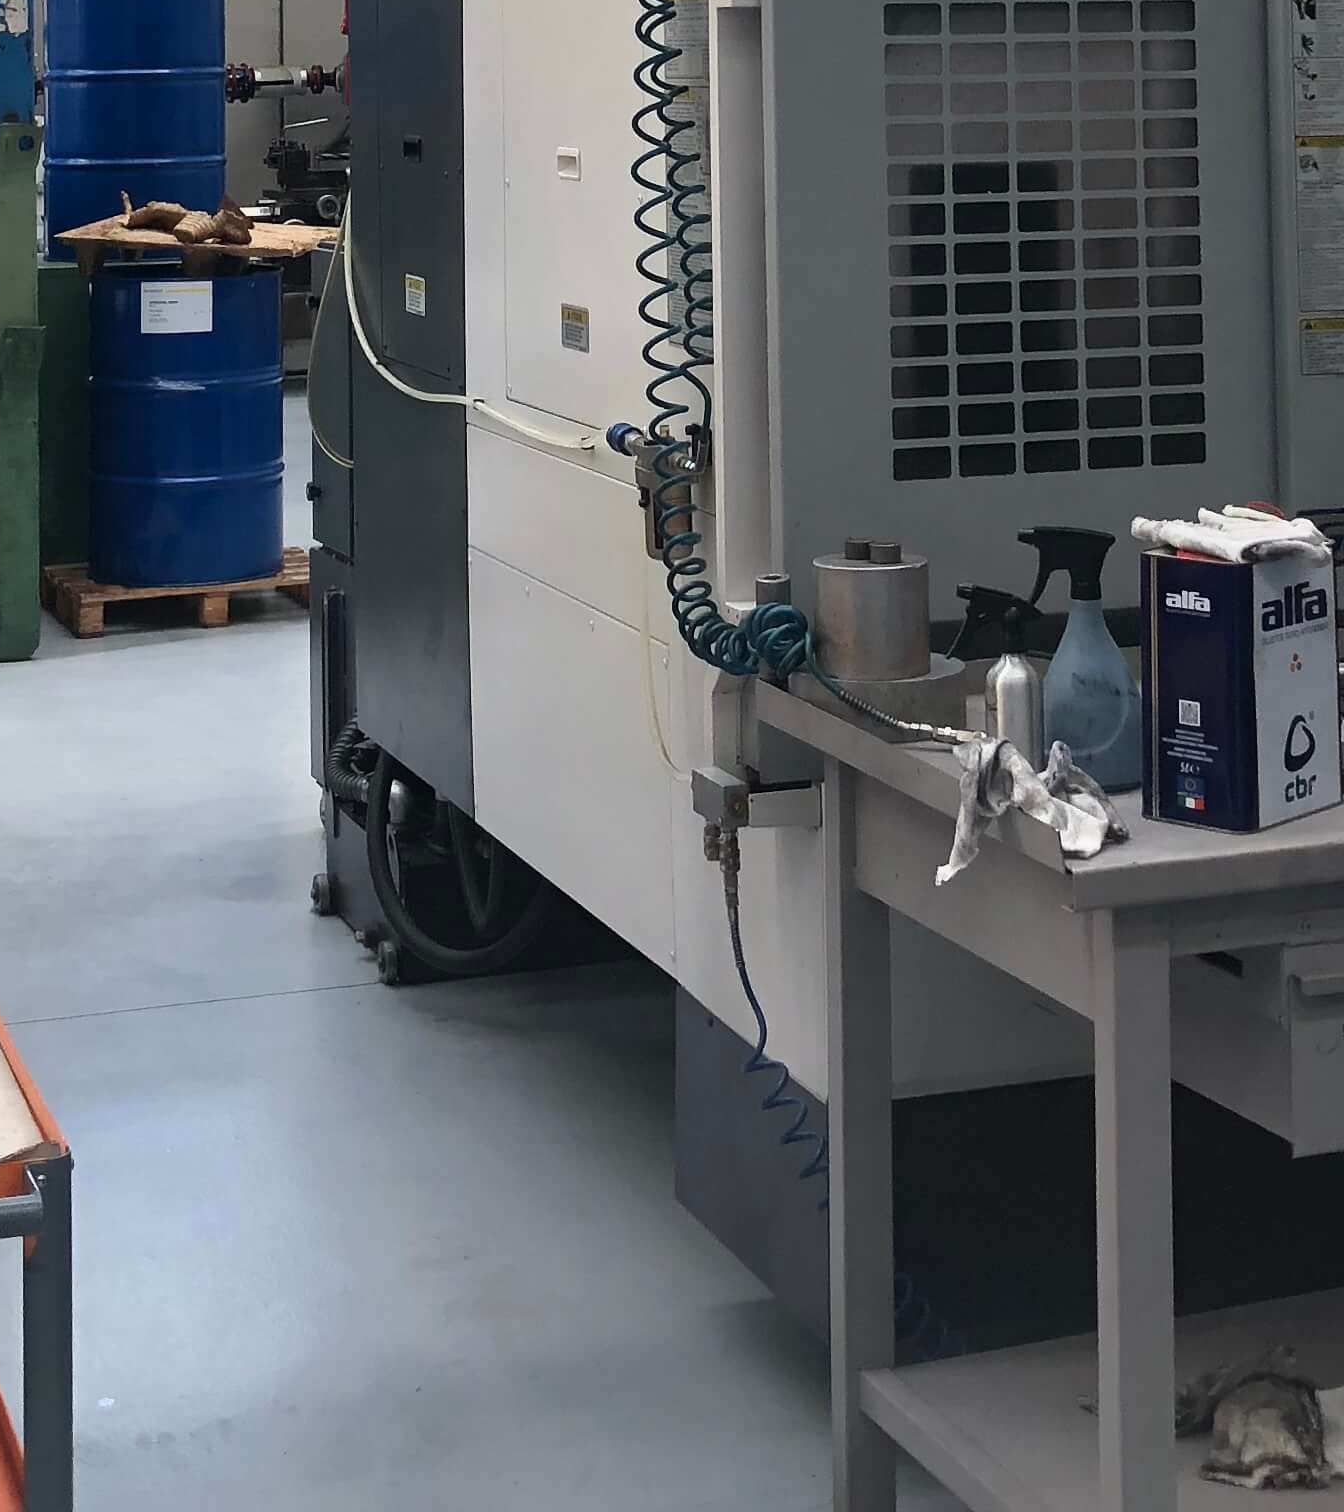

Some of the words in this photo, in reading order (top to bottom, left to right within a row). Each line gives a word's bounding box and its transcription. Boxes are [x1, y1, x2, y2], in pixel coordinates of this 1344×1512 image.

[1165, 589, 1212, 613] alfa
[1261, 580, 1329, 633] alfa
[1284, 774, 1317, 804] cbr
